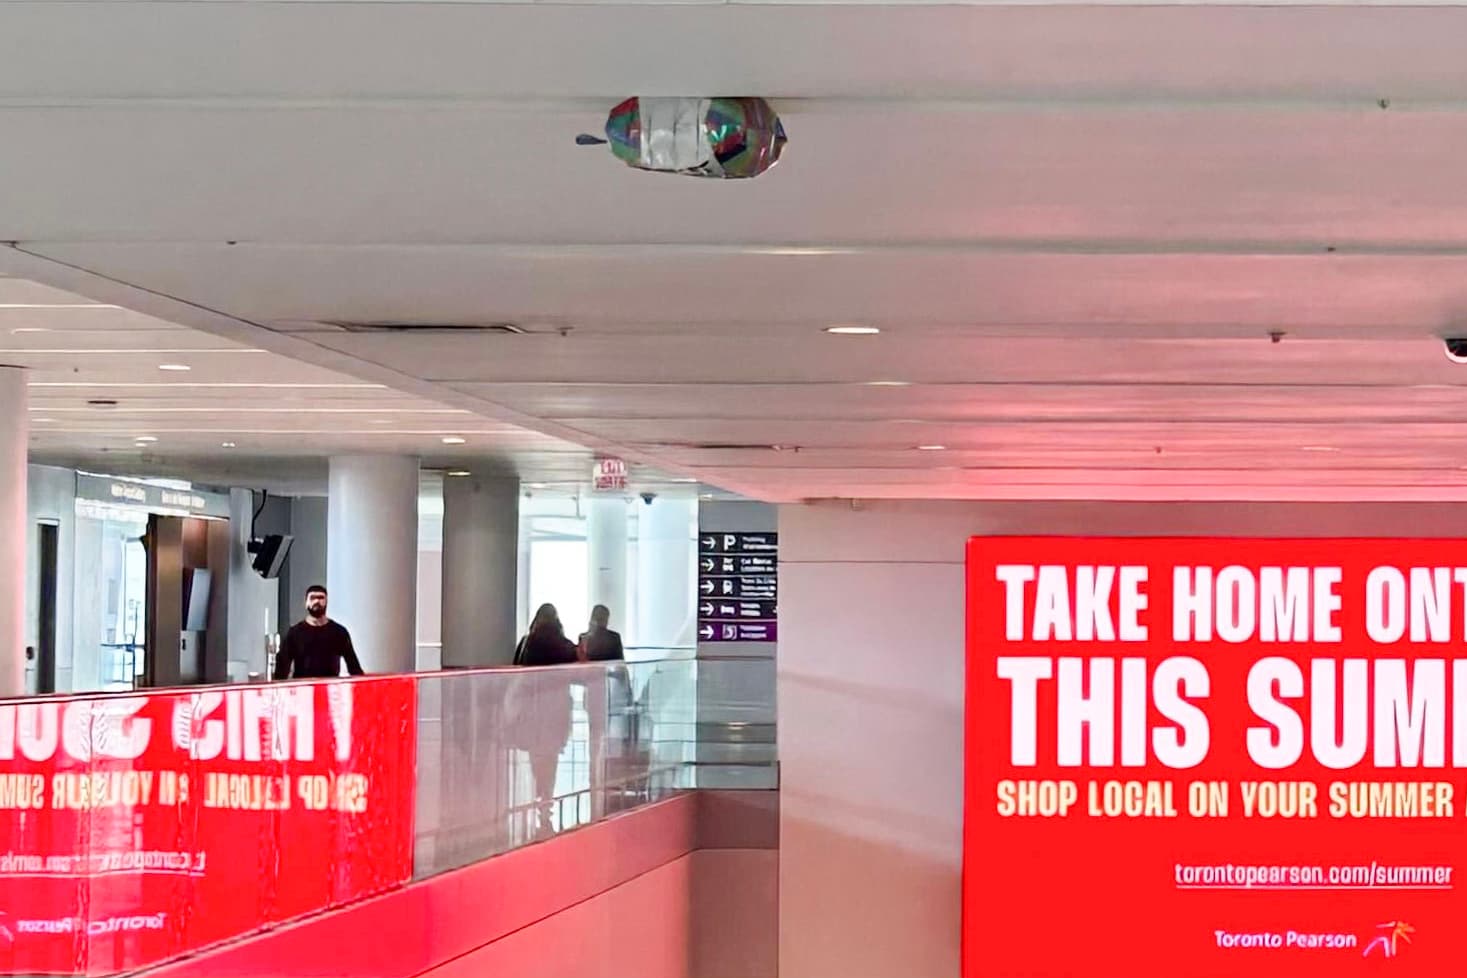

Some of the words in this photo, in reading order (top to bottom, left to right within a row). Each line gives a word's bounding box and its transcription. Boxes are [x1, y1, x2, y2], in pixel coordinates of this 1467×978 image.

[996, 565, 1149, 641] TAKE
[1172, 565, 1343, 642] HOME
[996, 656, 1210, 768] THIS
[997, 780, 1077, 817] SHOP
[1089, 781, 1178, 817] LOCAL
[1188, 781, 1229, 818] ON
[1241, 781, 1318, 818] YOUR
[1328, 781, 1454, 818] SUMMER
[1175, 861, 1453, 886] torontopearson.com/summer
[1214, 930, 1283, 948] Toronto
[1286, 930, 1357, 948] Pearson
